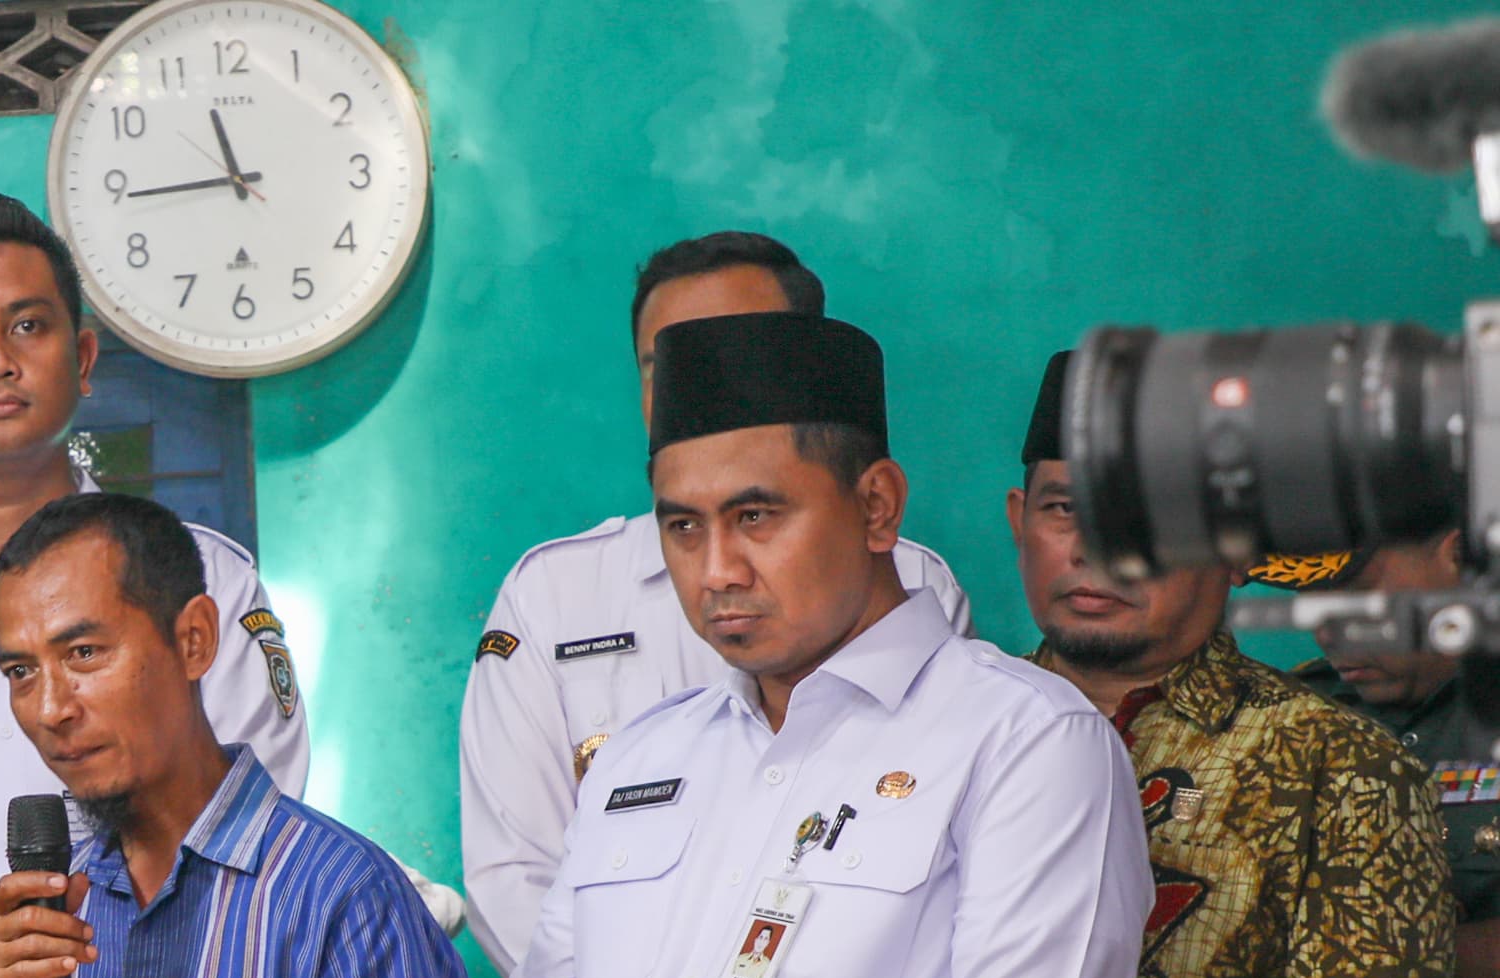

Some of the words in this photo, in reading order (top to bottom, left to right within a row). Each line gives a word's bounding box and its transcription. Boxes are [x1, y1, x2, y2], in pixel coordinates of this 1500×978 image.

[159, 56, 185, 91] 11
[212, 39, 250, 76] 12
[290, 49, 301, 83] 1
[110, 105, 147, 140] 10
[329, 92, 354, 128] 2
[104, 168, 128, 205] 9
[347, 153, 371, 190] 3
[127, 233, 150, 269] 8
[332, 220, 358, 254] 4
[173, 274, 198, 309] 7
[291, 267, 315, 301] 5
[231, 283, 256, 321] 6
[564, 643, 591, 655] BENNY
[592, 638, 617, 650] INDRA
[619, 637, 626, 646] A
